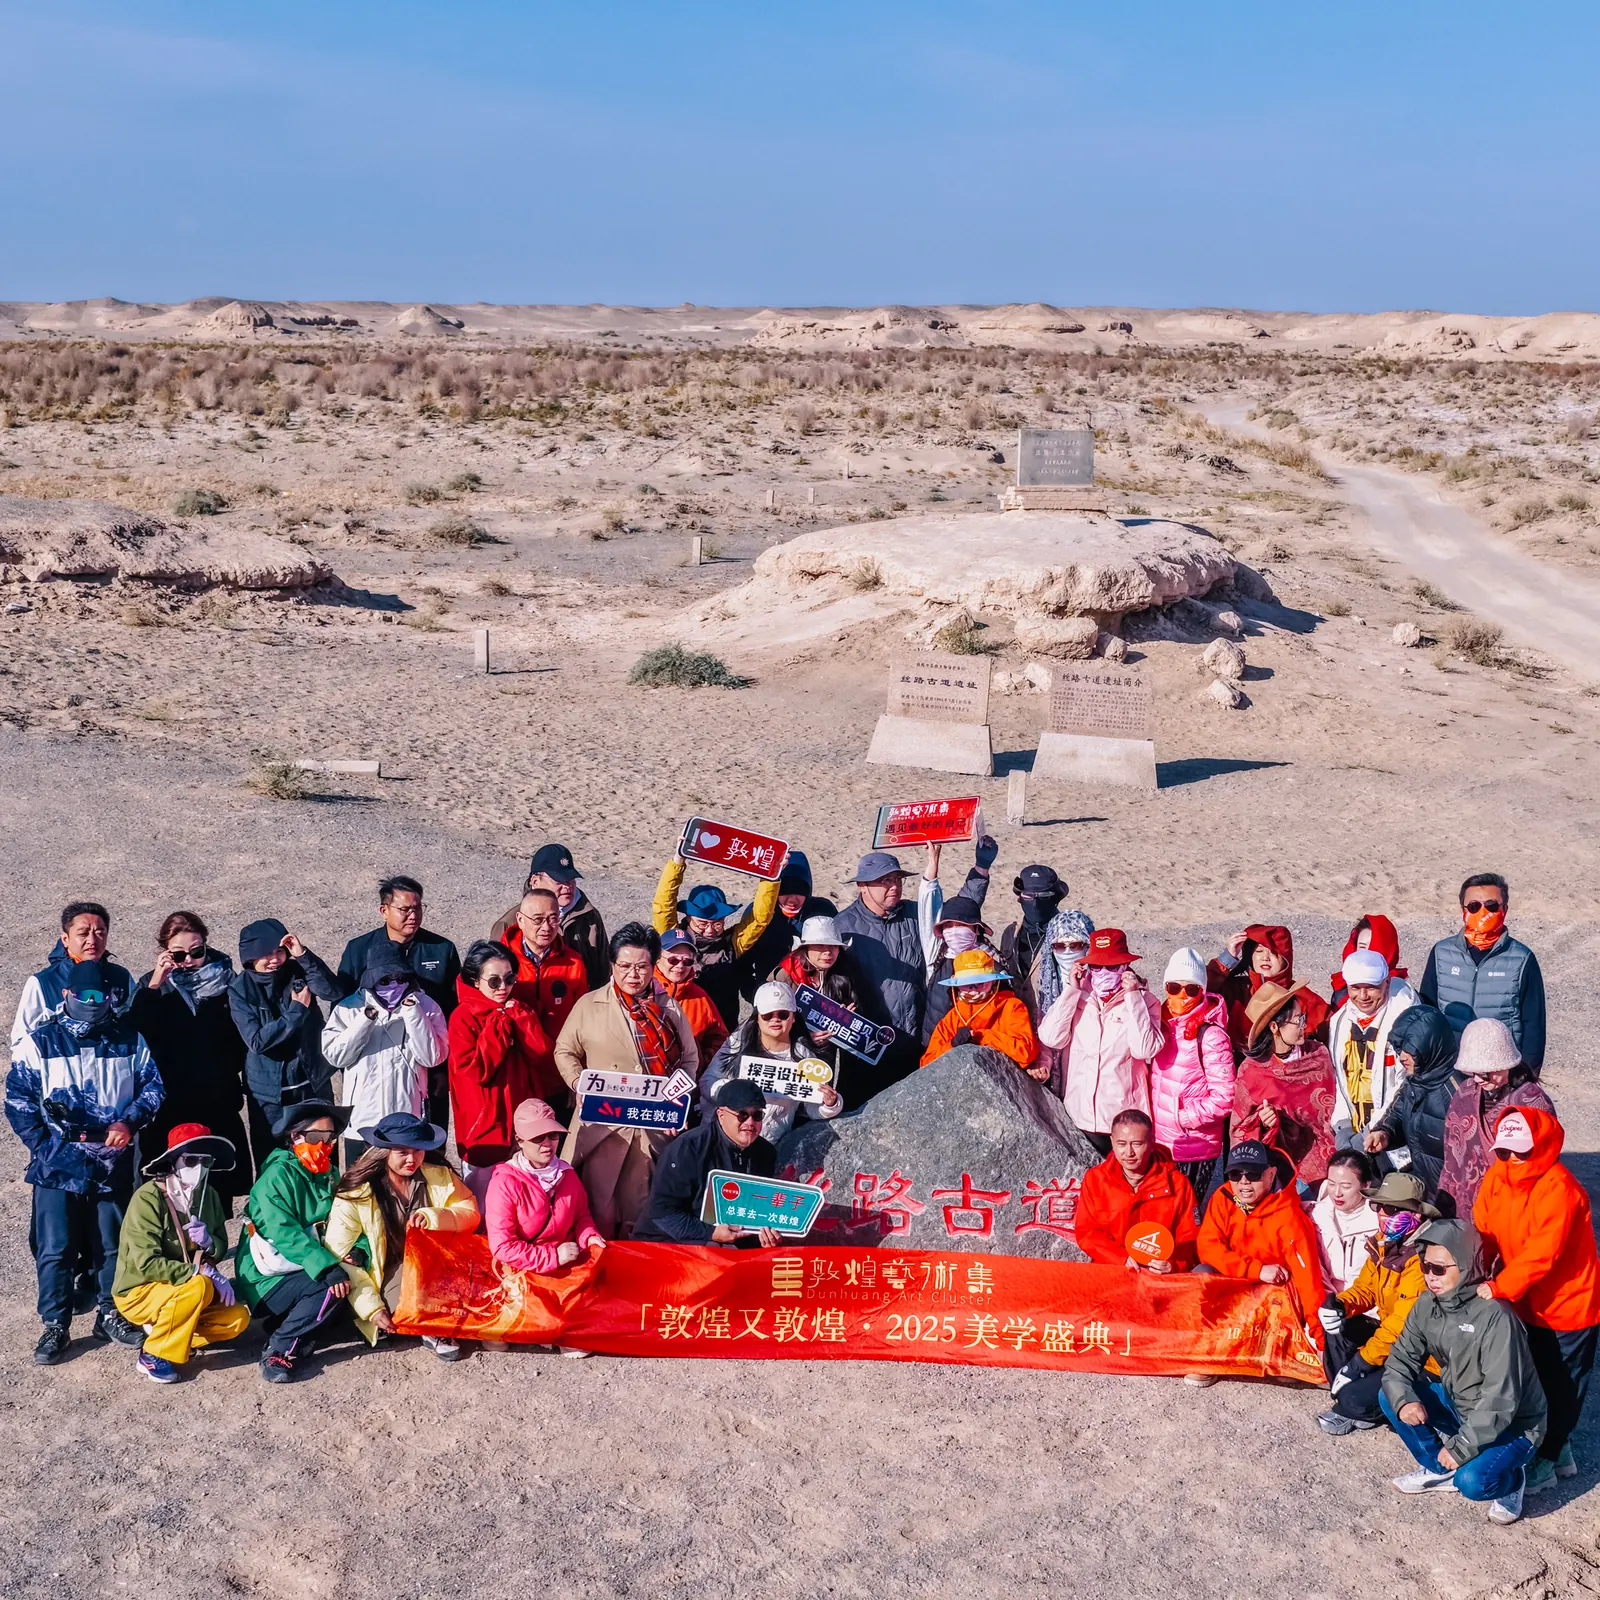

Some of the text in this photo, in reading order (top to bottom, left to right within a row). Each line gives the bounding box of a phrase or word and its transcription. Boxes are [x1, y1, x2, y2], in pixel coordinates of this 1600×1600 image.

[723, 837, 775, 871] 敦煌
[799, 990, 874, 1036] 在 遇见
[806, 1008, 862, 1046] 更好的自己
[802, 1061, 829, 1079] GO!
[586, 1073, 606, 1092] 为
[642, 1078, 662, 1097] 打
[667, 1077, 688, 1097] call
[626, 1107, 679, 1124] 我在敦煌
[752, 1192, 806, 1211] 一辈子
[725, 1205, 800, 1227] 总要去一次敦煌
[806, 1289, 993, 1305] Dunhuang Art Cluster
